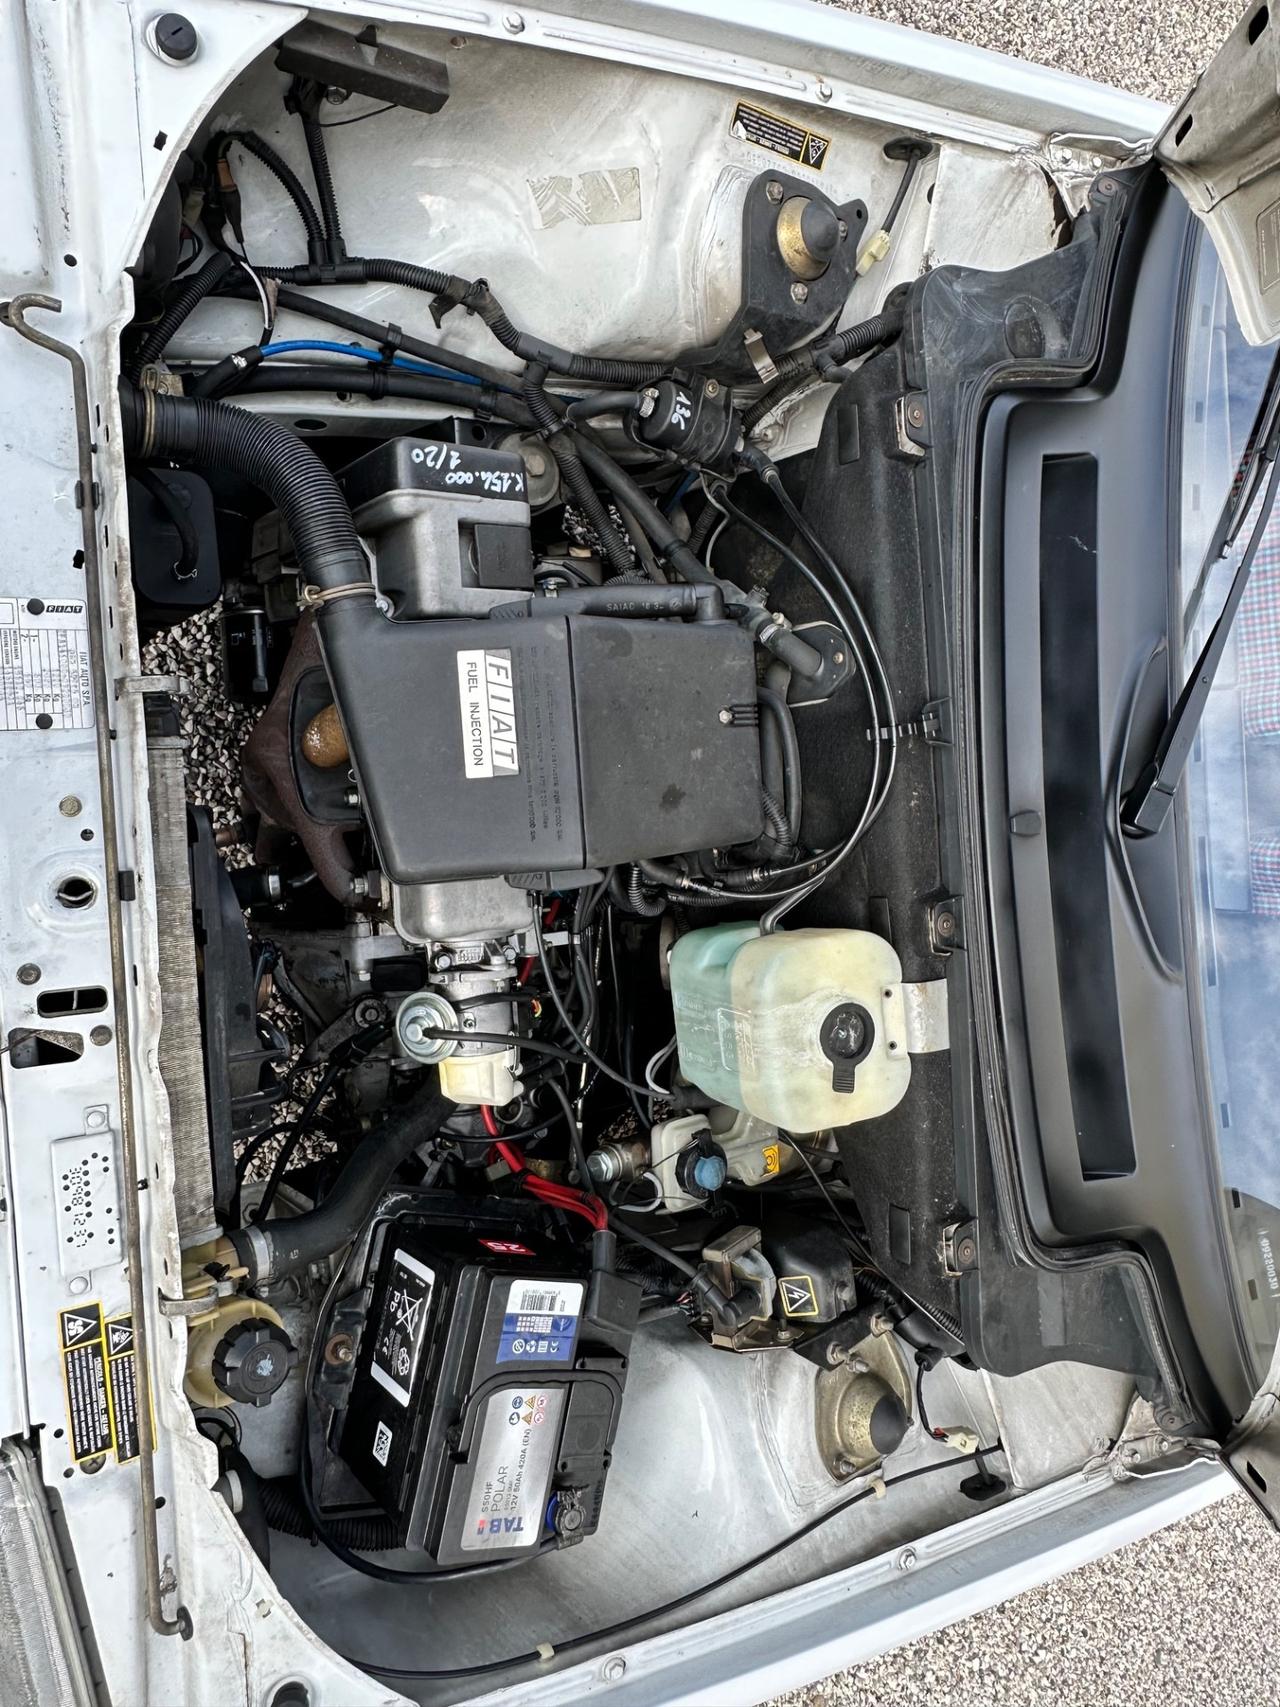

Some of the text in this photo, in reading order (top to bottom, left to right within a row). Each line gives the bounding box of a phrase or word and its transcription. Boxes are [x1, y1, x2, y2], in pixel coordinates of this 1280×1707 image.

[410, 444, 462, 470] 1/20
[46, 605, 83, 614] FIAT
[80, 668, 90, 687] AUTO
[466, 661, 485, 767] FUEL INJECTION
[487, 662, 516, 764] FIAT
[389, 1290, 401, 1312] Pb
[510, 1428, 532, 1511] 12V 50Ah 420A (EN)
[490, 1465, 509, 1513] POLAR
[488, 1515, 524, 1535] TAB
